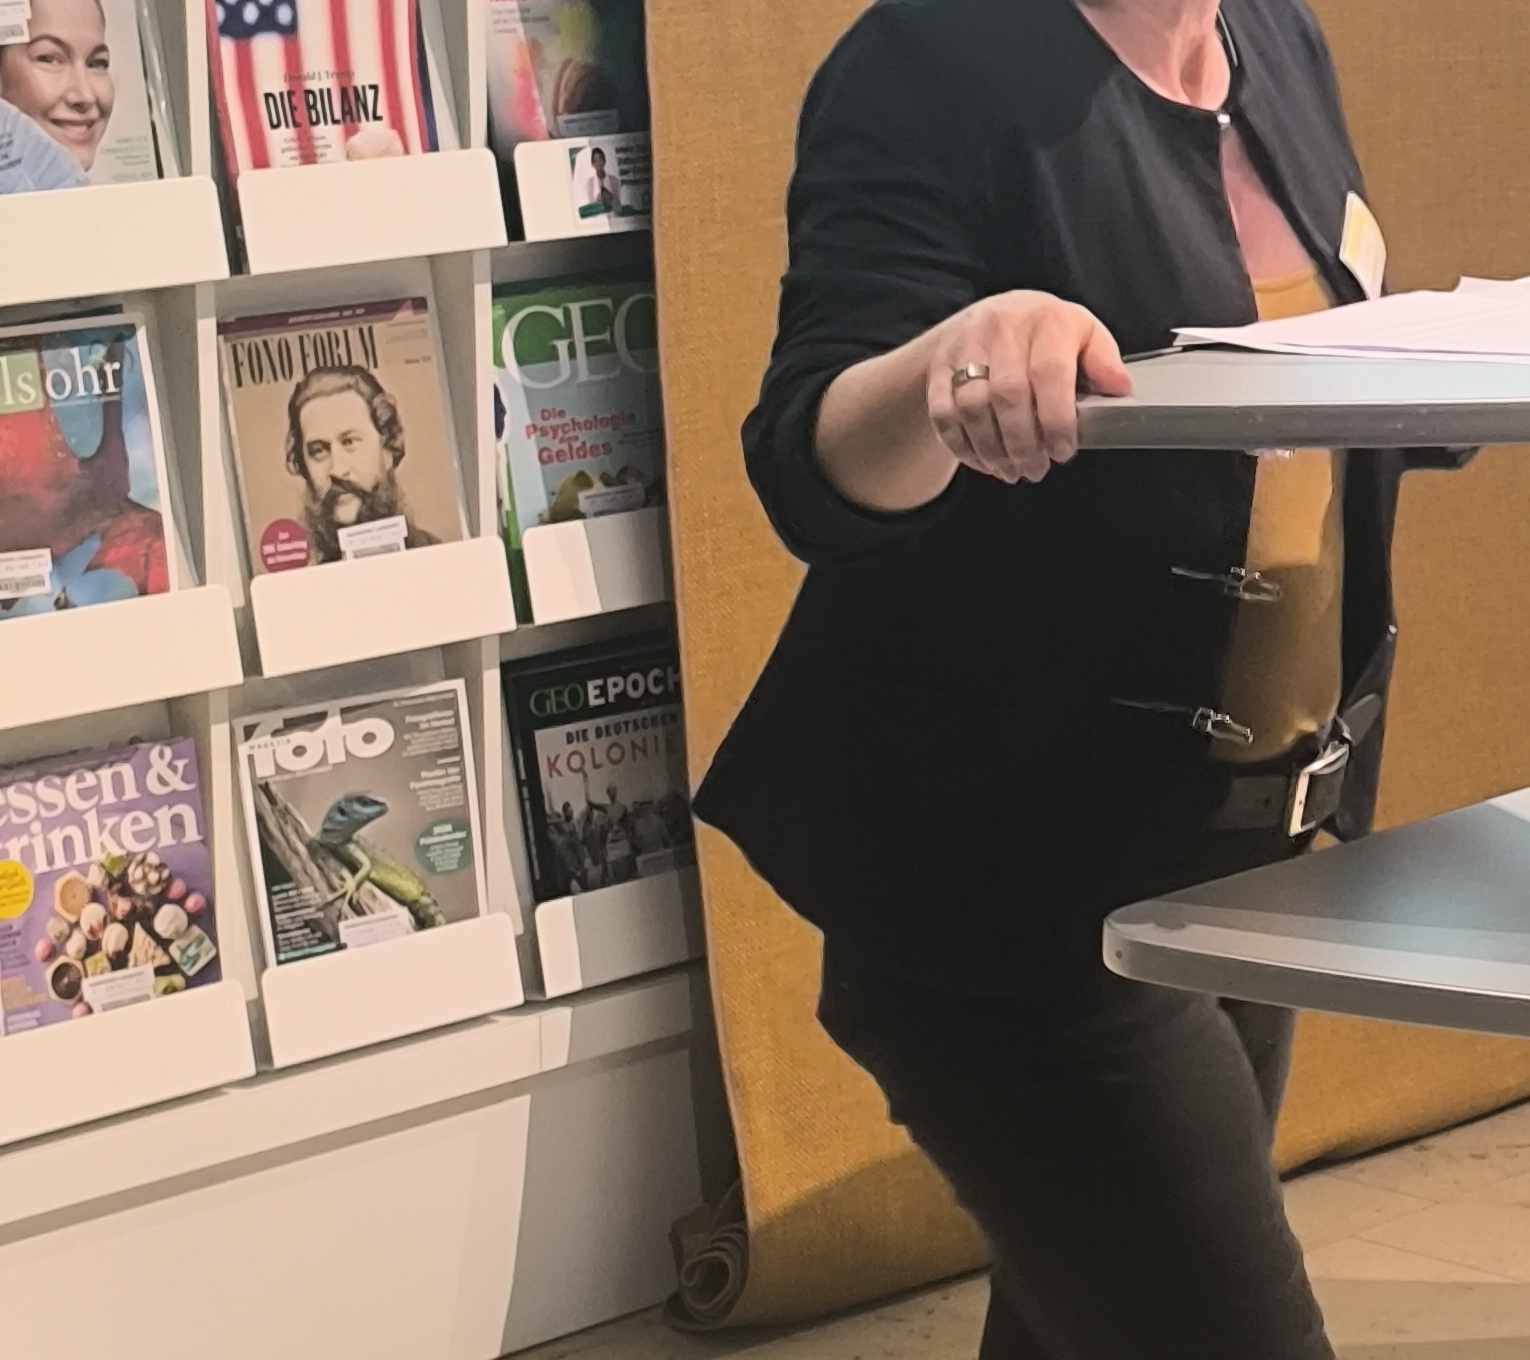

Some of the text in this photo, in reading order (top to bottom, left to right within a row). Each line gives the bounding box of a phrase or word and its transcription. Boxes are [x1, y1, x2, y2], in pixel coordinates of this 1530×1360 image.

[263, 83, 384, 130] DIE BILANZ
[501, 293, 657, 389] GEO
[231, 325, 379, 388] FONO FORUM
[525, 411, 636, 440] Psychologie
[540, 407, 567, 422] Die
[538, 442, 613, 466] Geldes
[565, 728, 590, 746] DIE
